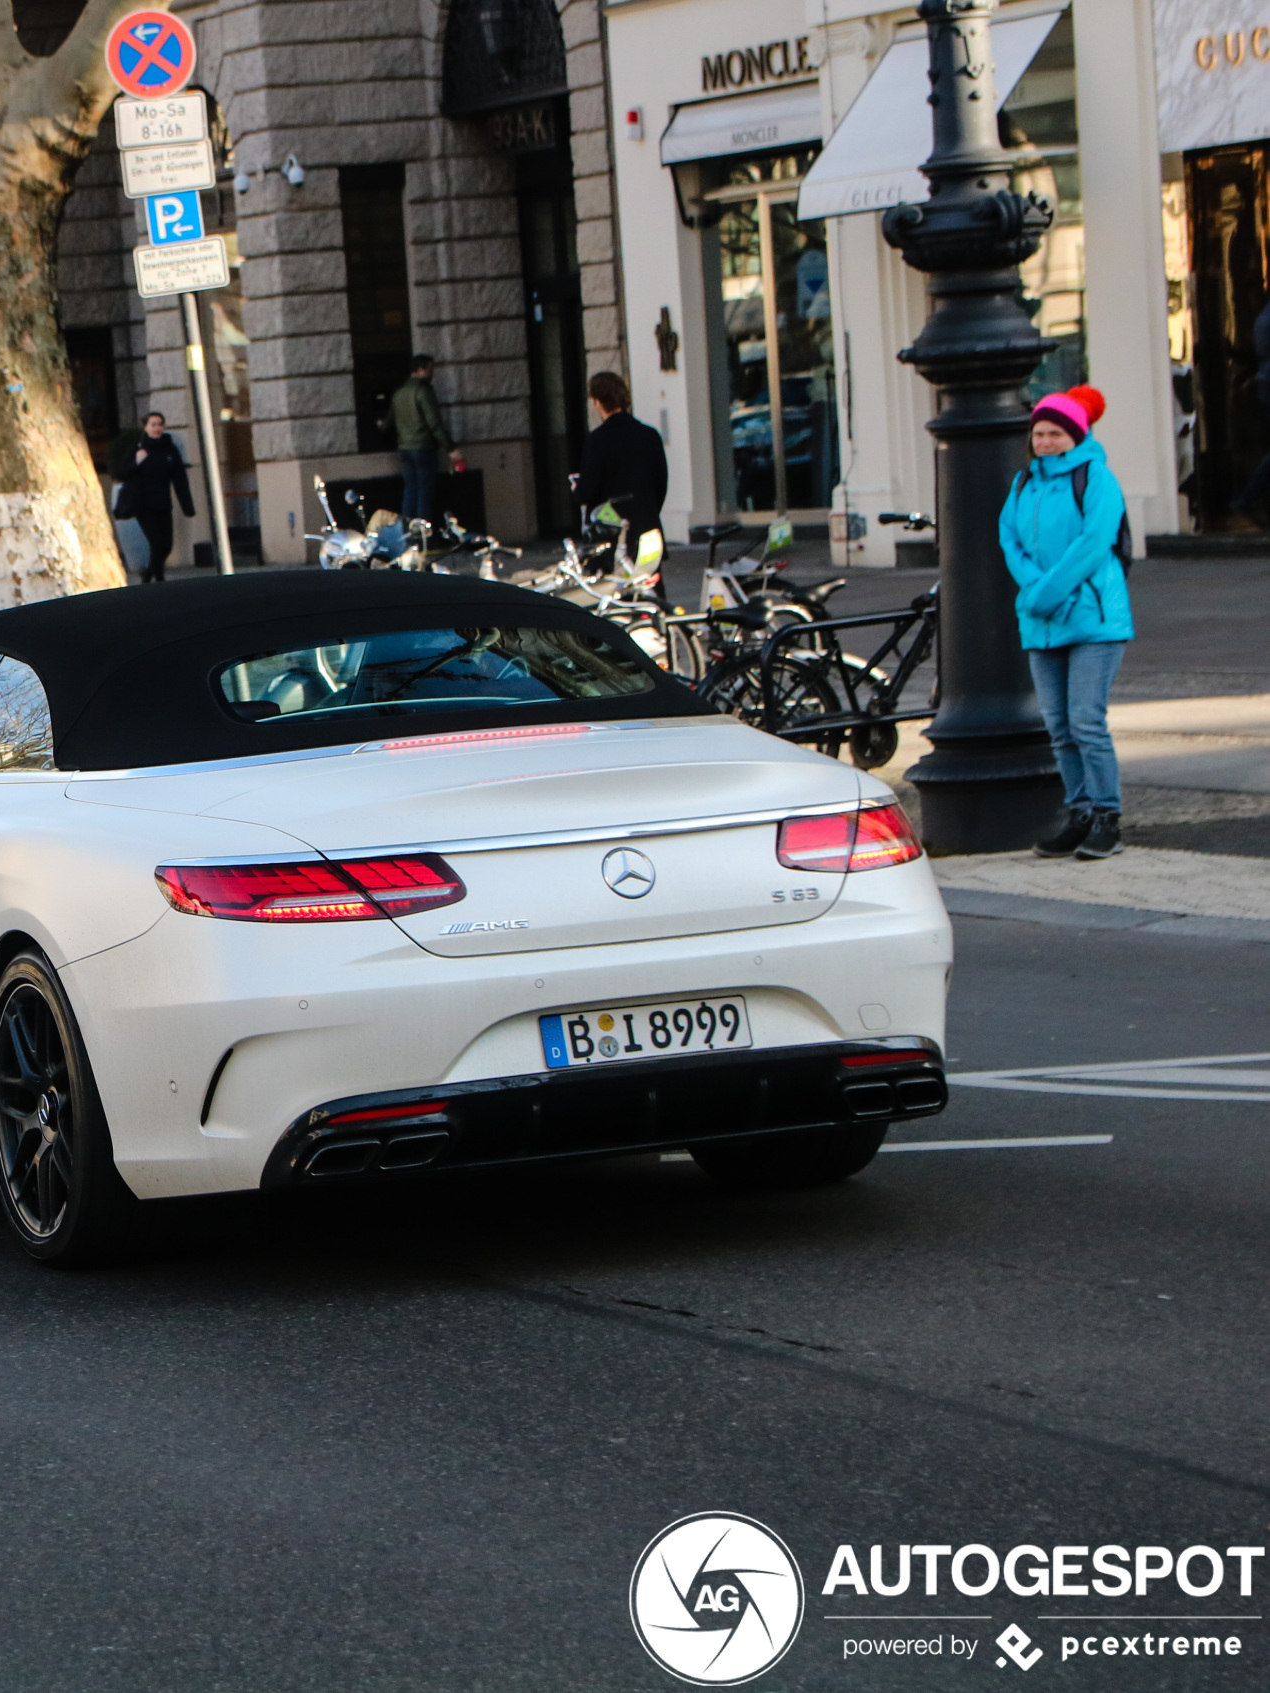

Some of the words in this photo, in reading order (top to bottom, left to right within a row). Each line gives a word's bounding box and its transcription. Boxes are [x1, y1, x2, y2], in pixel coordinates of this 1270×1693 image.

[701, 36, 818, 92] MONCLE
[135, 103, 186, 120] Mo-Sa
[142, 123, 183, 140] 8-16h
[731, 126, 778, 146] MONCLER
[851, 184, 902, 207] GUCCI
[154, 196, 184, 239] P
[771, 890, 786, 903] S
[791, 887, 819, 901] 63
[469, 919, 529, 932] AMG
[551, 1047, 561, 1059] D
[568, 1018, 595, 1059] B
[623, 1014, 643, 1053] I
[649, 1003, 740, 1049] 8999
